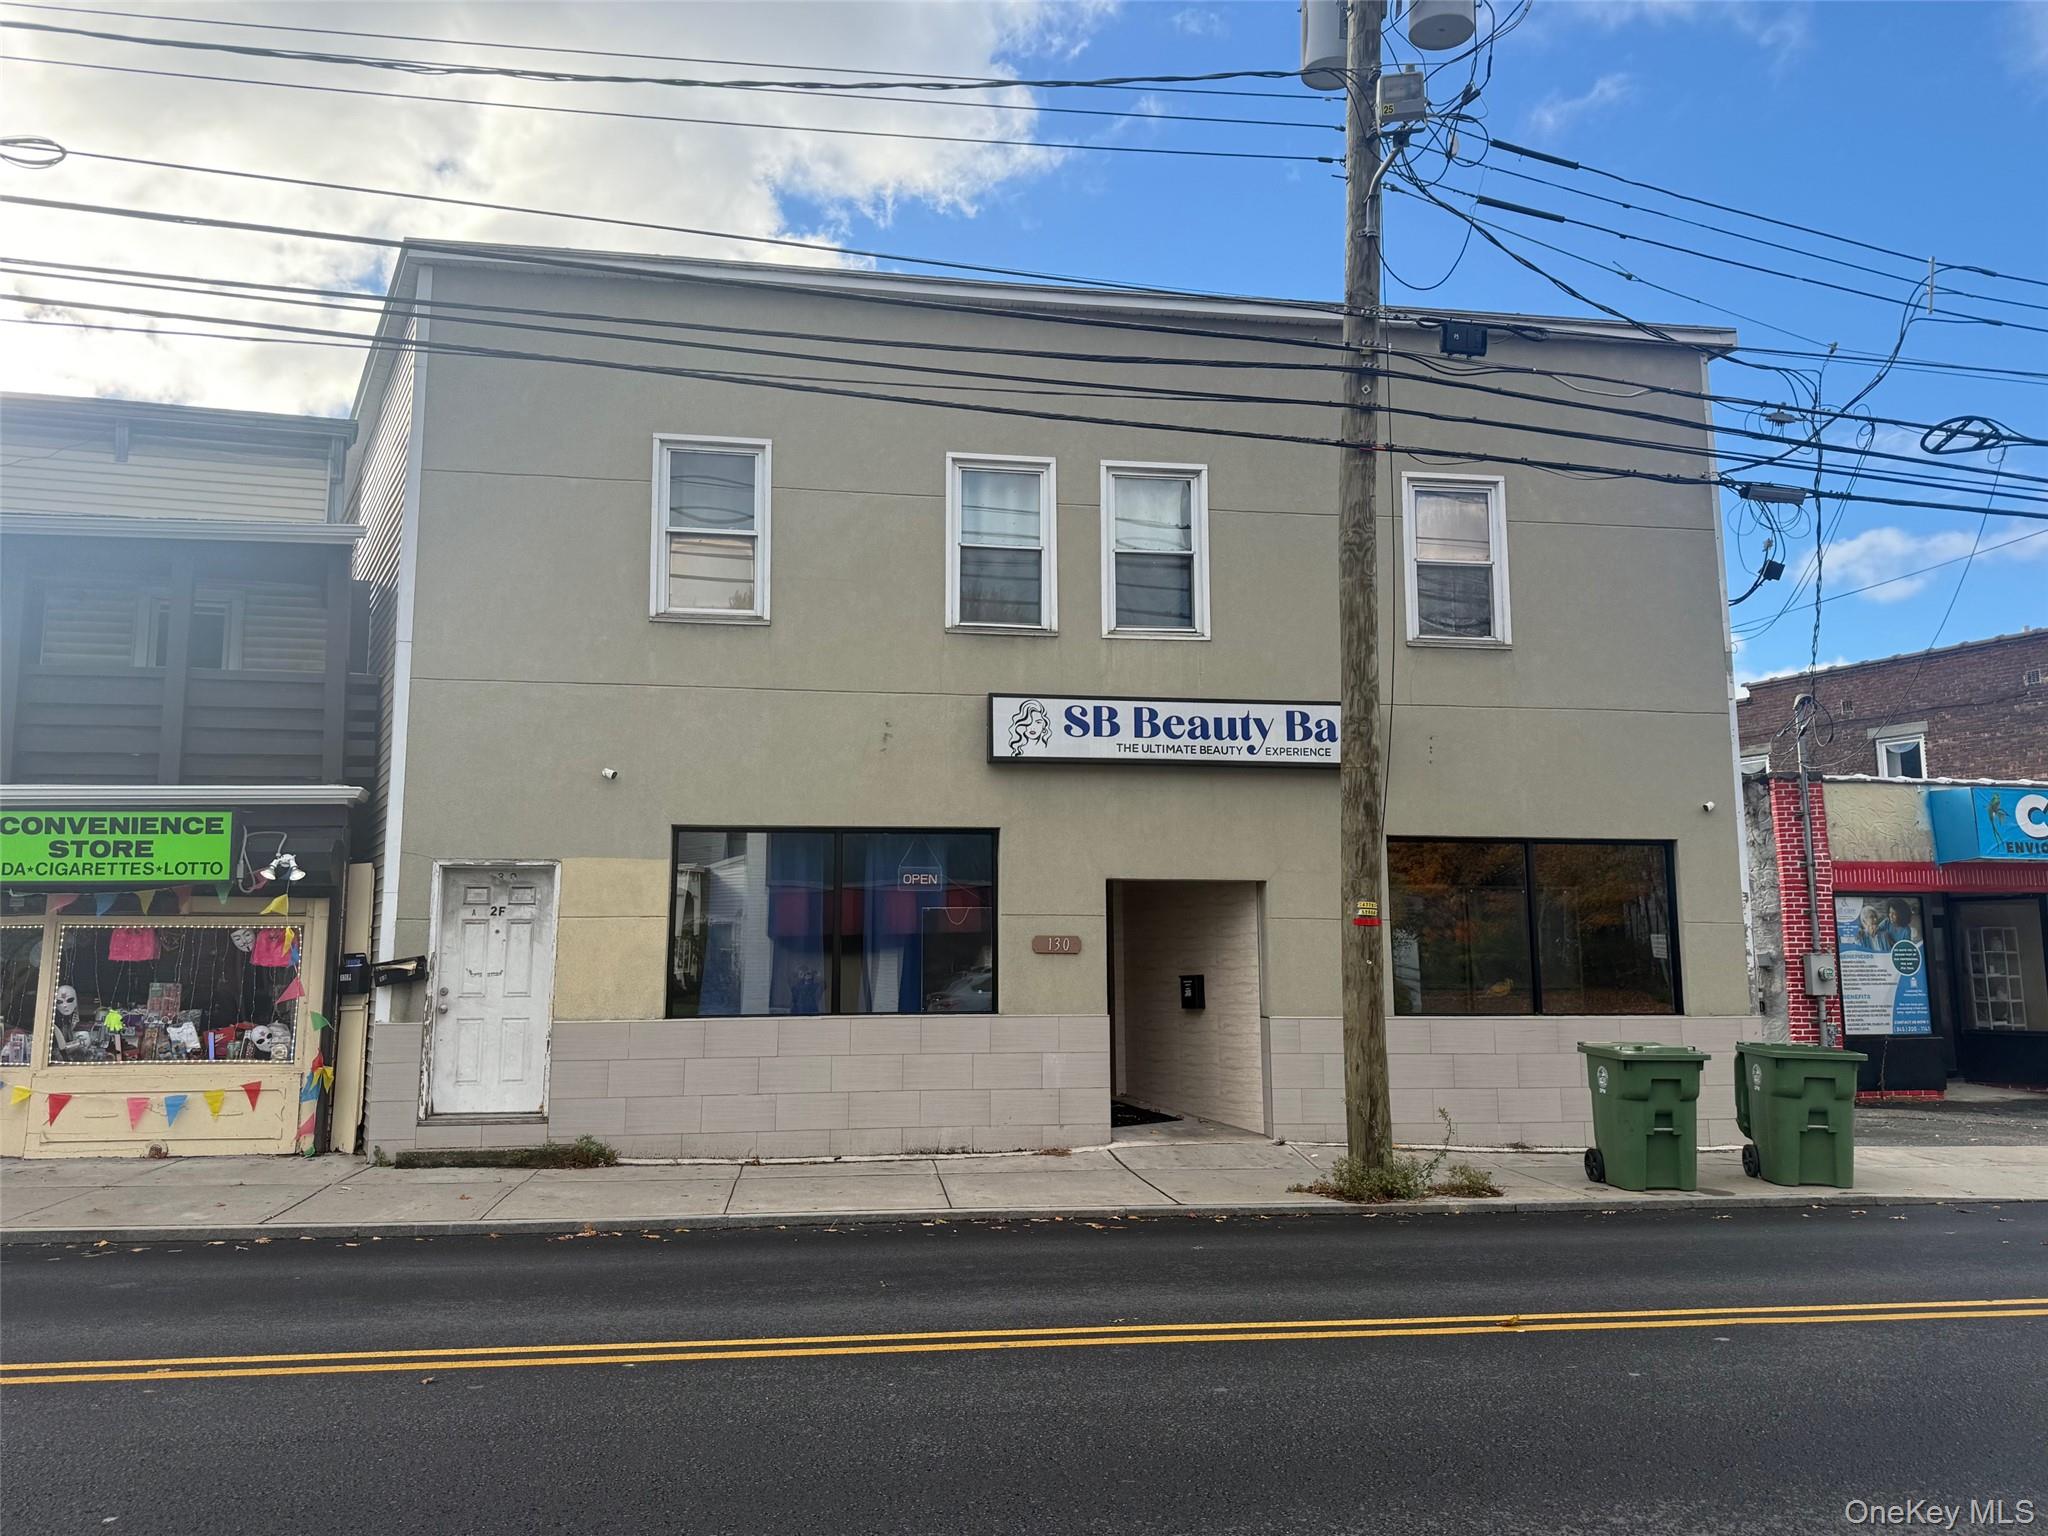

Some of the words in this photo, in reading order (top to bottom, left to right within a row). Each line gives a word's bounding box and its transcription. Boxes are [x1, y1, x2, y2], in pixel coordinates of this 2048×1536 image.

[1384, 105, 1394, 114] 25
[1064, 705, 1121, 738] SB
[1134, 707, 1274, 755] Beauty
[1286, 710, 1339, 743] Ba
[1116, 743, 1139, 753] THE
[1141, 744, 1197, 755] ULTIMATE
[1200, 745, 1243, 756] BEAUTY
[1265, 747, 1332, 757] EXPERIENCE
[0, 816, 224, 836] CONVENIENCE
[48, 840, 154, 858] STORE
[164, 861, 223, 876] LOTTO
[903, 874, 938, 885] OPEN
[490, 906, 507, 917] 2F
[1048, 937, 1071, 951] 130
